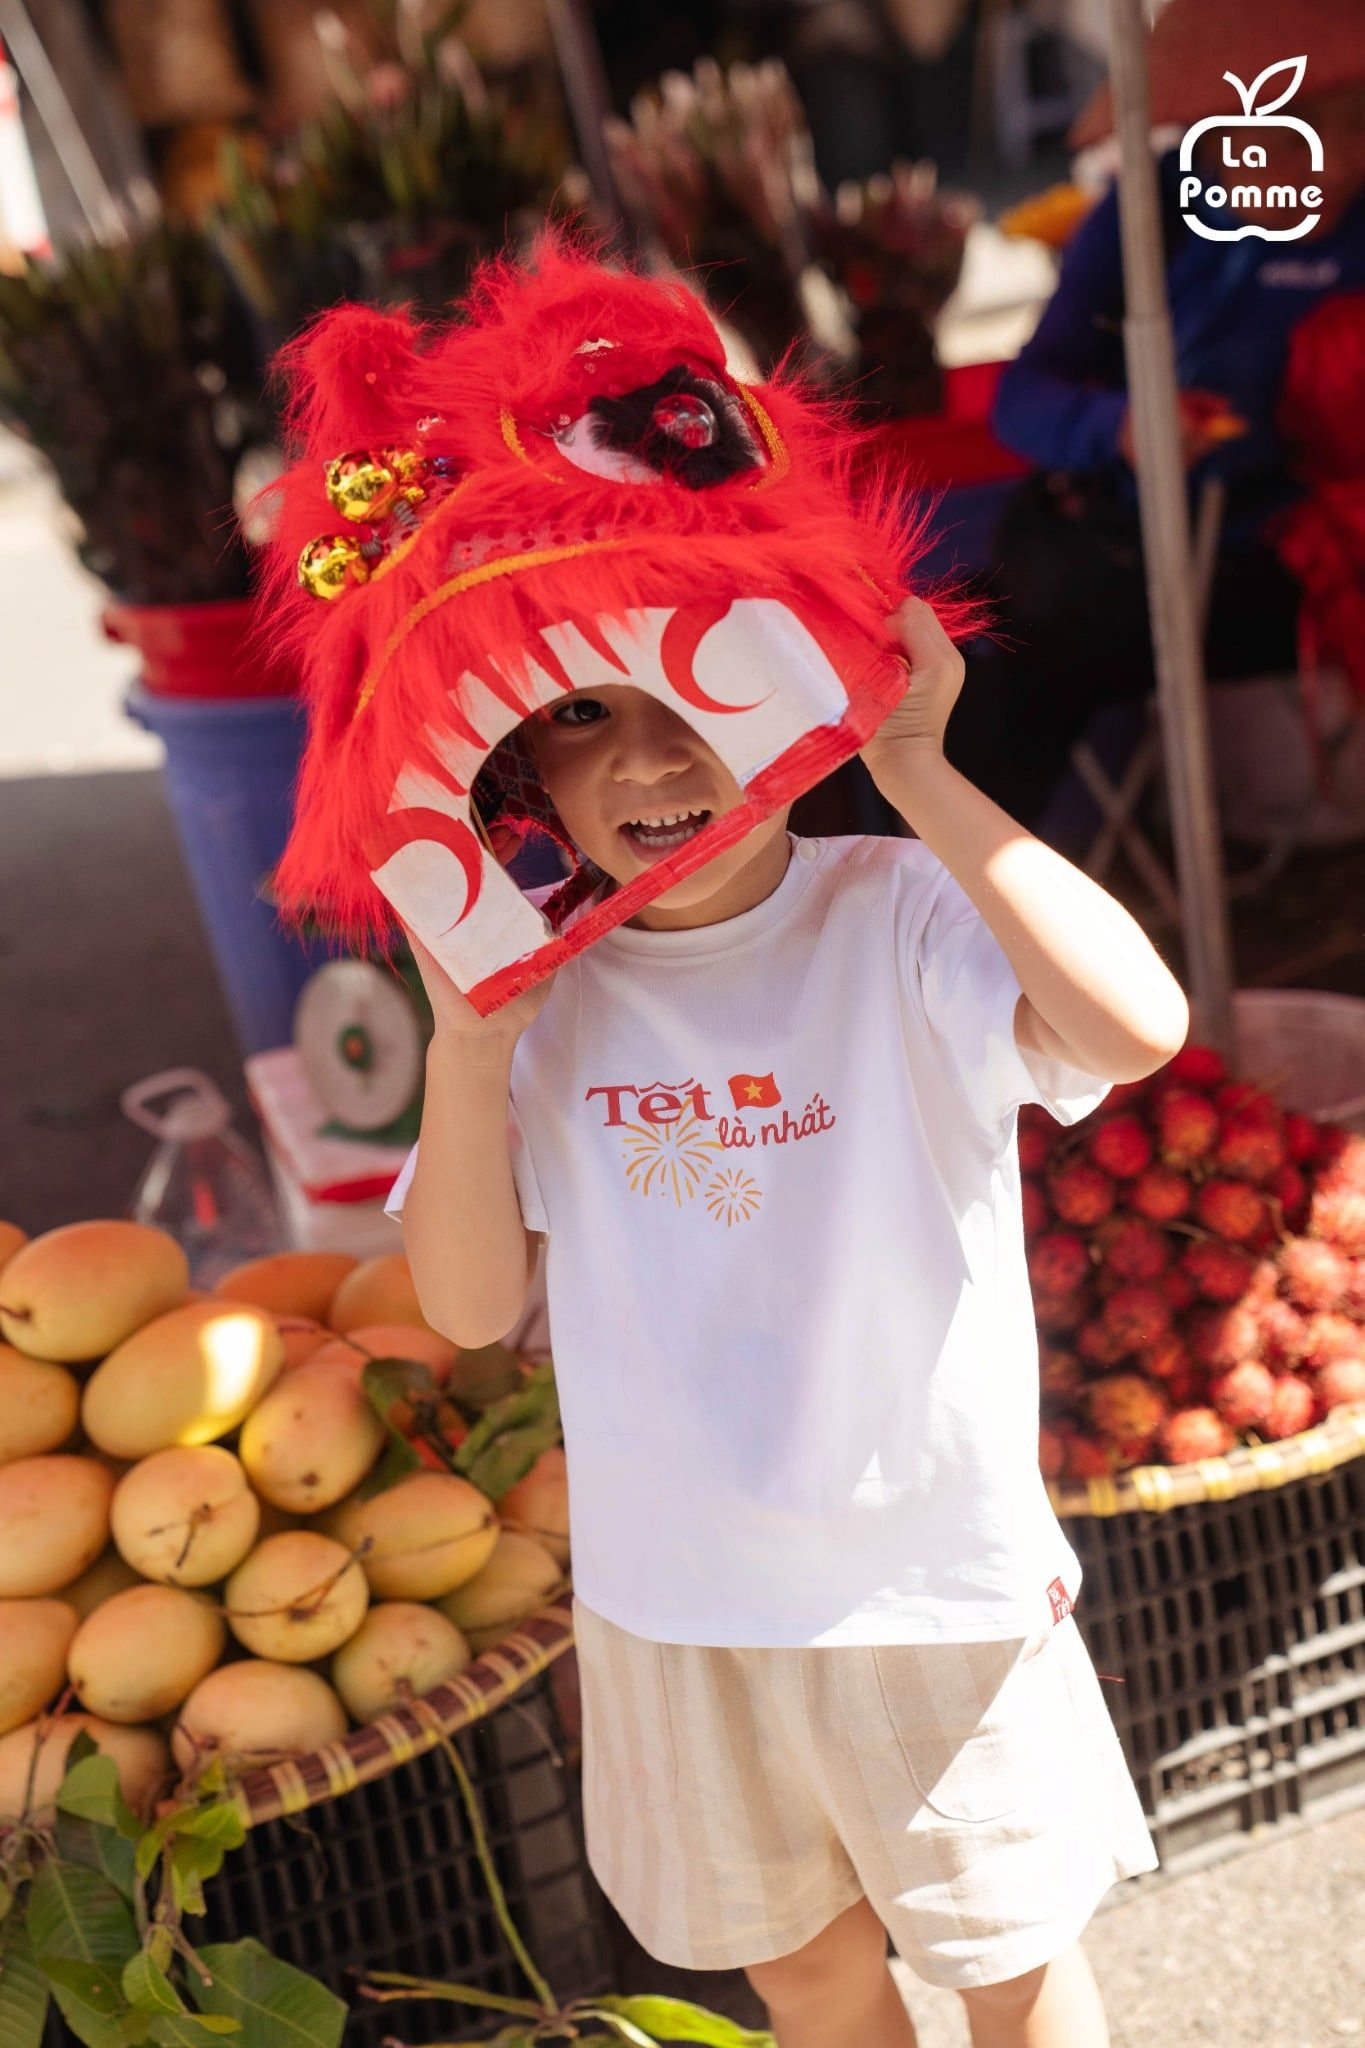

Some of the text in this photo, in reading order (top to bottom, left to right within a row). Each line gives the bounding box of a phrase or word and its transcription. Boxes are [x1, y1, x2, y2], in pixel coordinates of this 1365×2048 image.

[585, 1077, 715, 1126] Tết
[718, 1093, 836, 1148] là nhất
